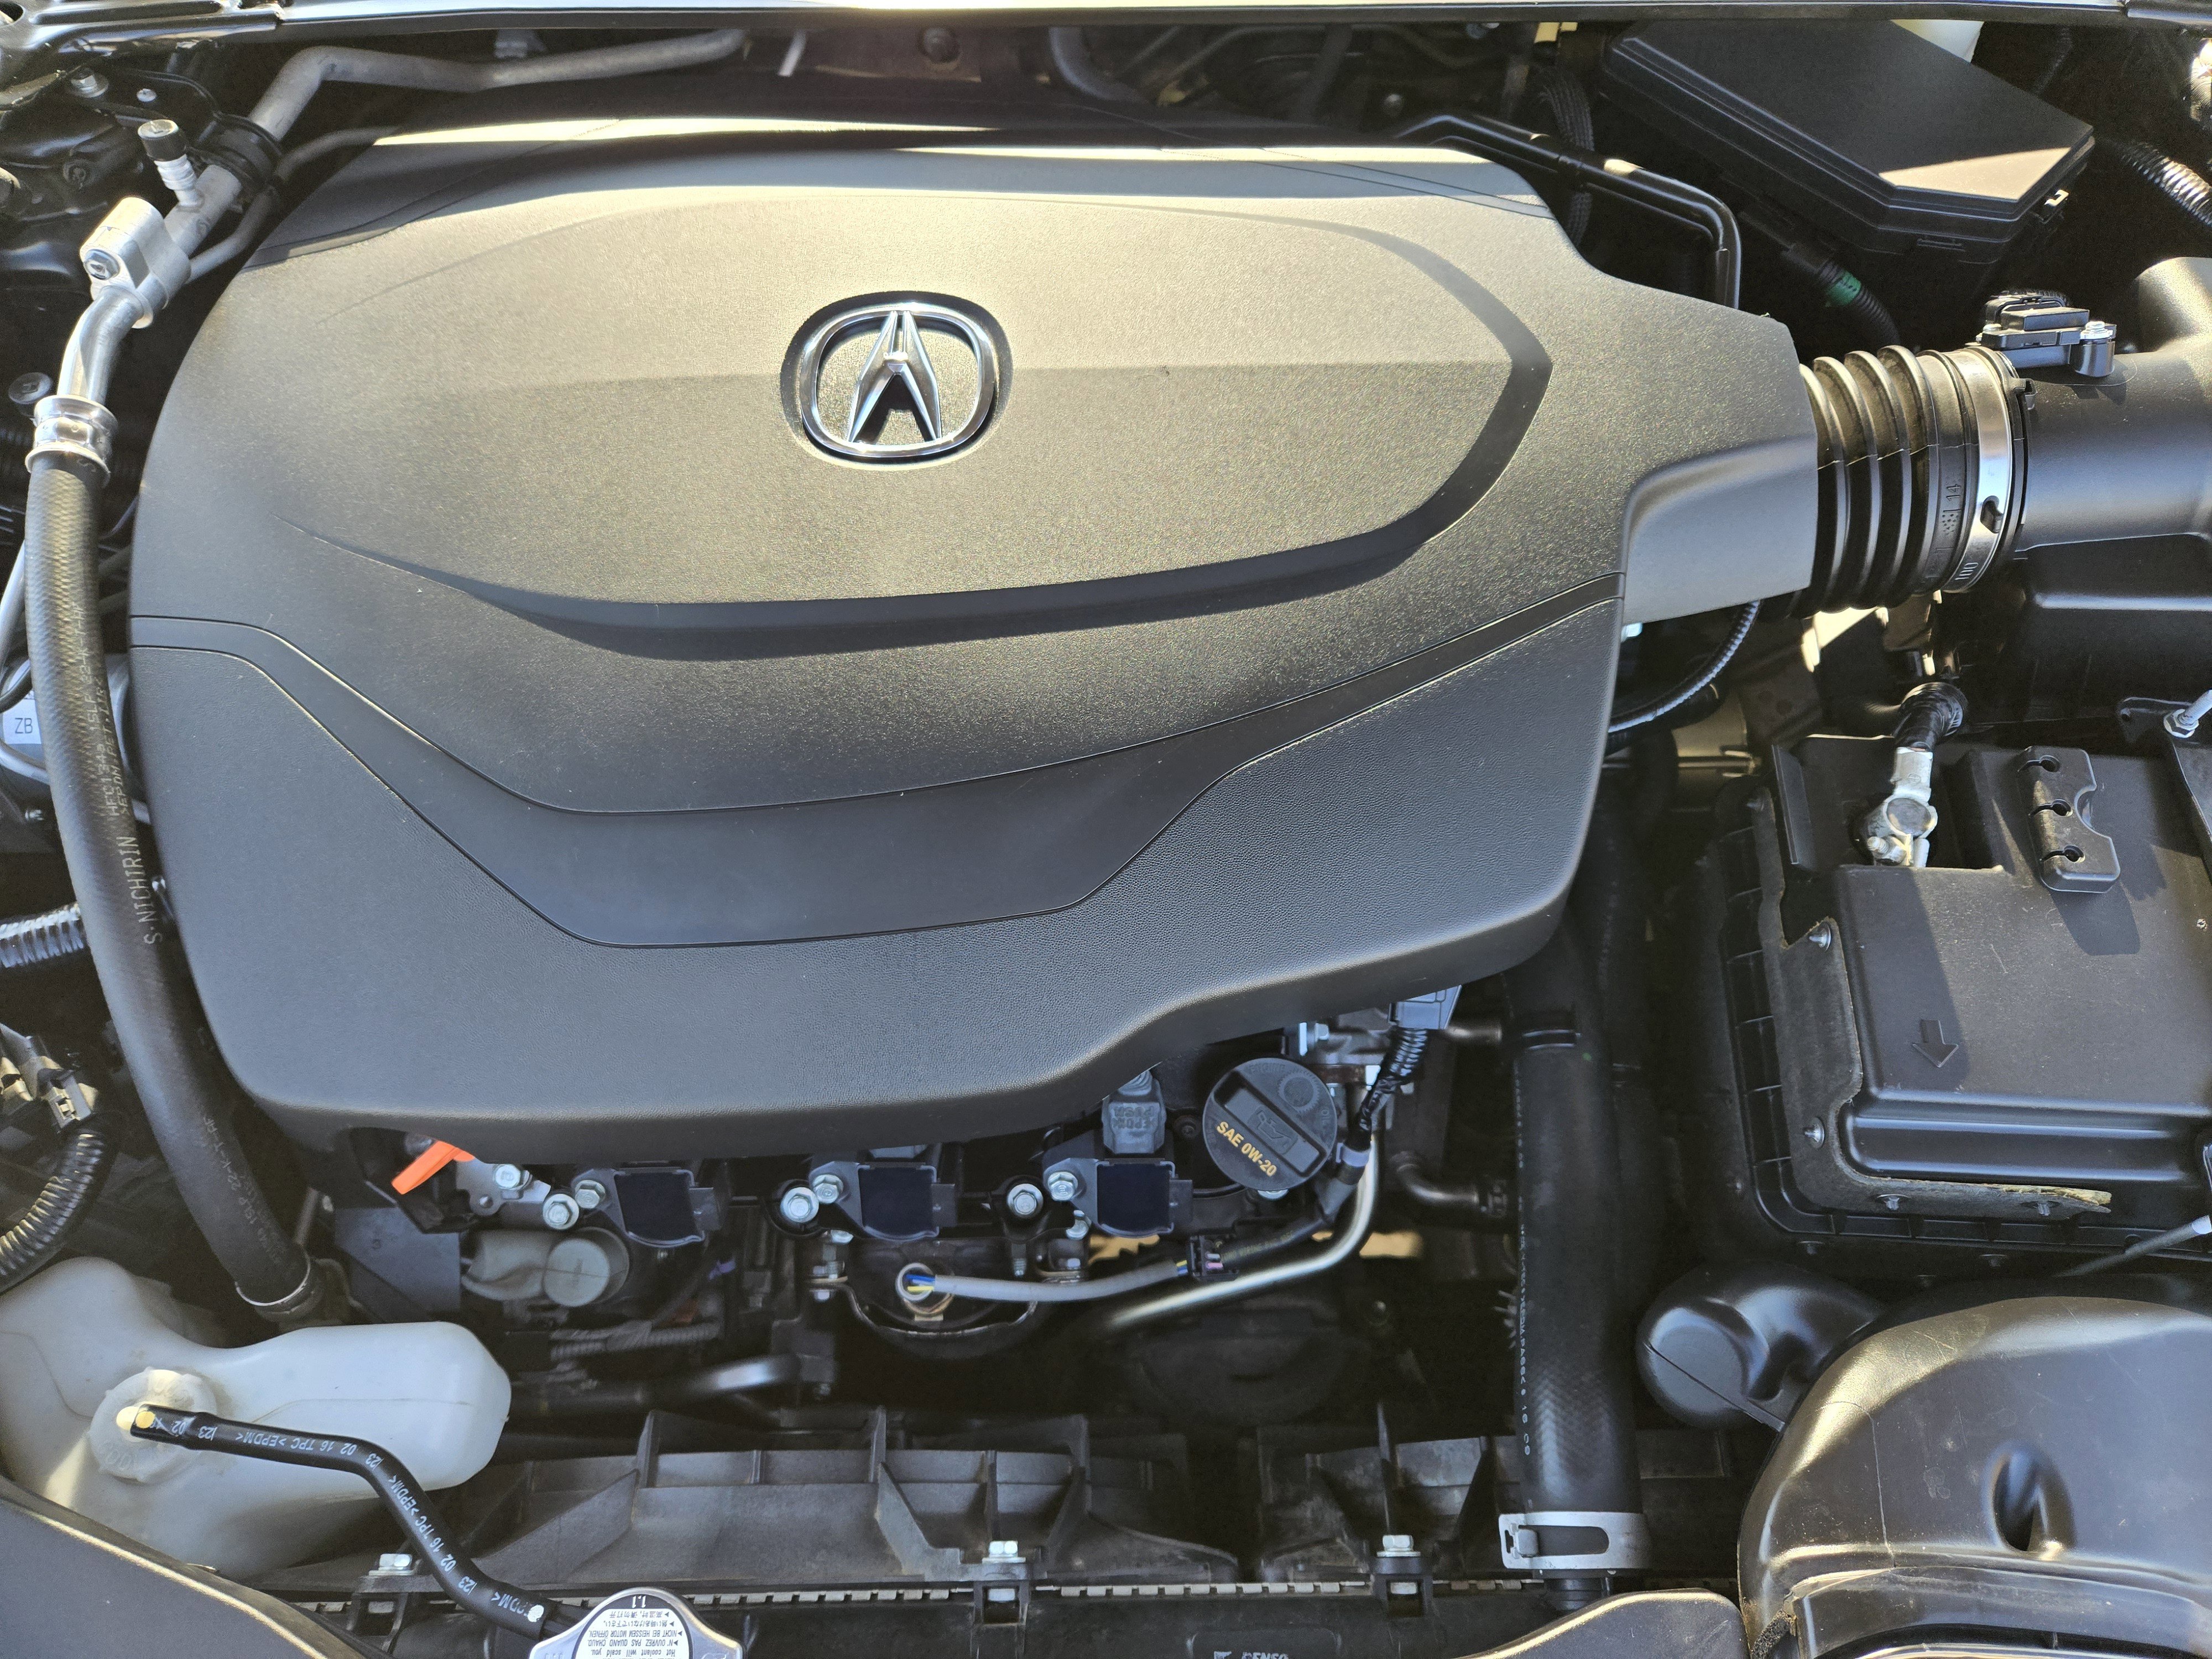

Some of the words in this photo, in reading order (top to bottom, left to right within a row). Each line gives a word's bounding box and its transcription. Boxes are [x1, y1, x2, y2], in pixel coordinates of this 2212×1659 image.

[1955, 561, 1979, 581] 100
[14, 717, 33, 734] ZB
[1215, 1120, 1243, 1149] SAE
[1241, 1142, 1277, 1177] 0W-20
[291, 1437, 315, 1451] TPC
[320, 1440, 335, 1452] 16
[340, 1442, 357, 1455] 02
[414, 1515, 435, 1540] TPC
[429, 1537, 444, 1553] 16
[440, 1553, 457, 1572] 02
[632, 1595, 646, 1608] 1.1
[609, 1639, 628, 1647] QUAND
[606, 1649, 621, 1657] scald
[626, 1649, 637, 1657] will
[641, 1649, 661, 1657] coolant
[666, 1649, 675, 1657] Hot
